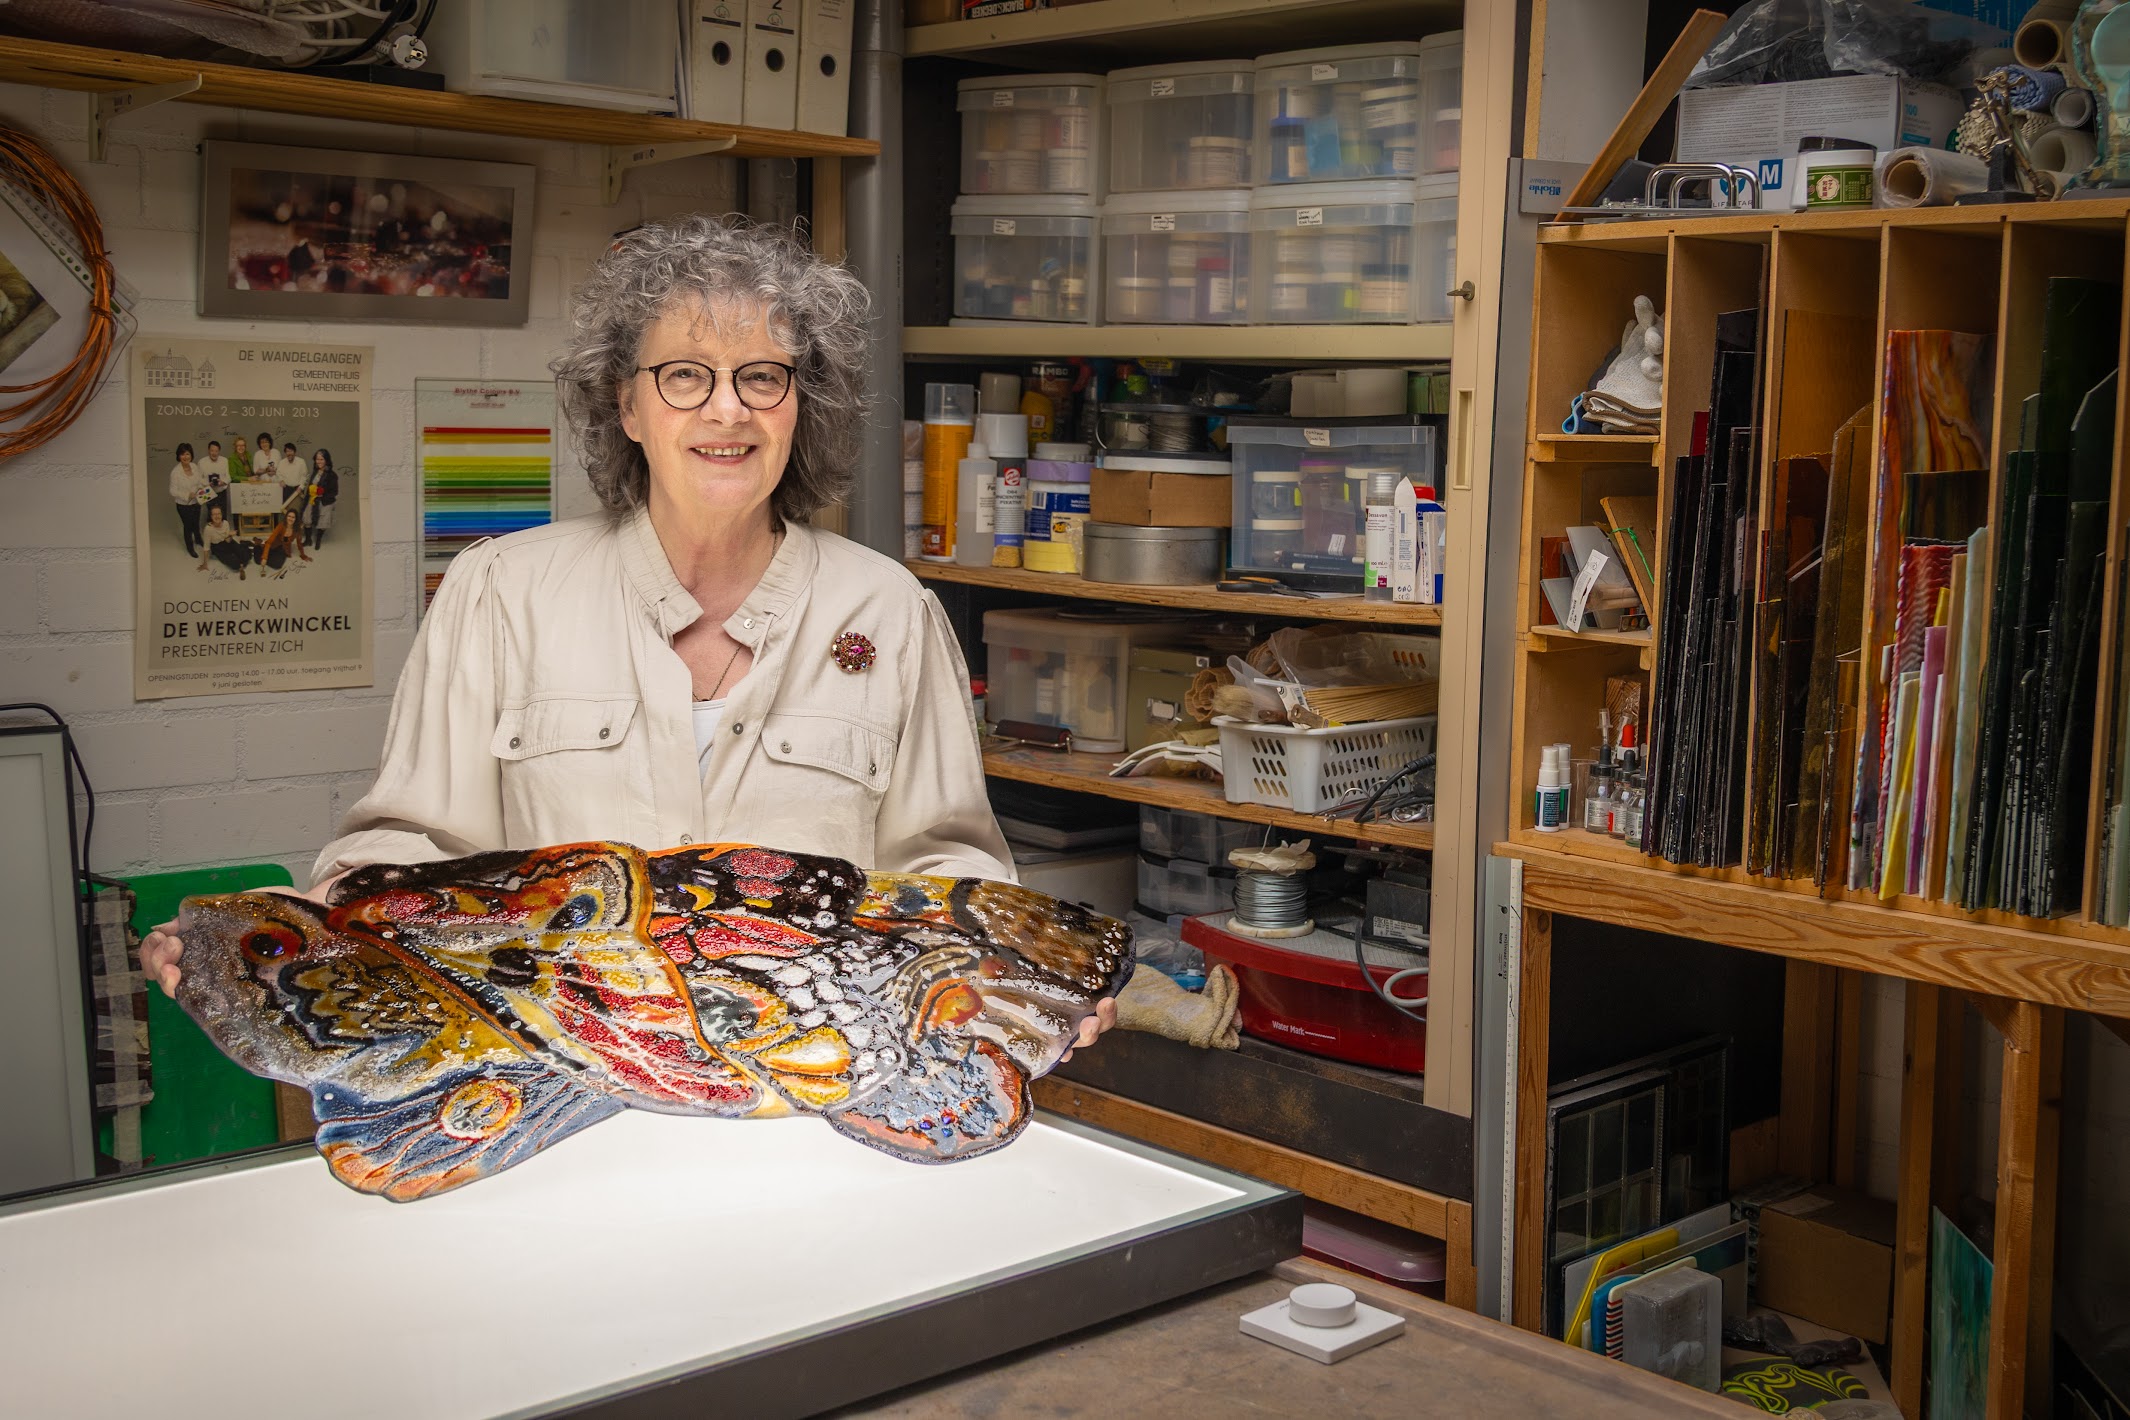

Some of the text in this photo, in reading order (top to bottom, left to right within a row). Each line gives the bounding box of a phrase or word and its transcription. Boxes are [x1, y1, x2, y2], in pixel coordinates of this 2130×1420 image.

[1762, 164, 1779, 185] M
[1529, 185, 1556, 196] Bohle
[1713, 200, 1753, 208] LIFTAR
[238, 349, 362, 364] DE WANDELGANGEN
[292, 369, 360, 380] GEMEENTEHUIS
[1031, 366, 1069, 376] RAMBO
[293, 383, 360, 393] HILVARENBEEK
[455, 387, 478, 395] Blythe
[157, 404, 213, 416] ZONDAG
[220, 405, 228, 417] 2
[241, 406, 256, 417] 30
[259, 407, 285, 418] JUNI
[292, 407, 320, 418] 2013
[164, 598, 288, 614] DOCENTEN VAN
[163, 615, 351, 638] DE WERCKWINCKEL
[162, 639, 304, 658] PRESENTEREN ZICH
[148, 673, 209, 682] OPENINGSTIJDEN
[212, 670, 239, 680] zondag
[242, 669, 259, 677] 14.00
[267, 668, 285, 676] 17.00
[301, 666, 331, 676] toegang
[333, 664, 357, 673] Vrijthof
[217, 680, 231, 689] juni
[232, 679, 262, 689] gesloten
[1271, 1020, 1306, 1036] Water Mark
